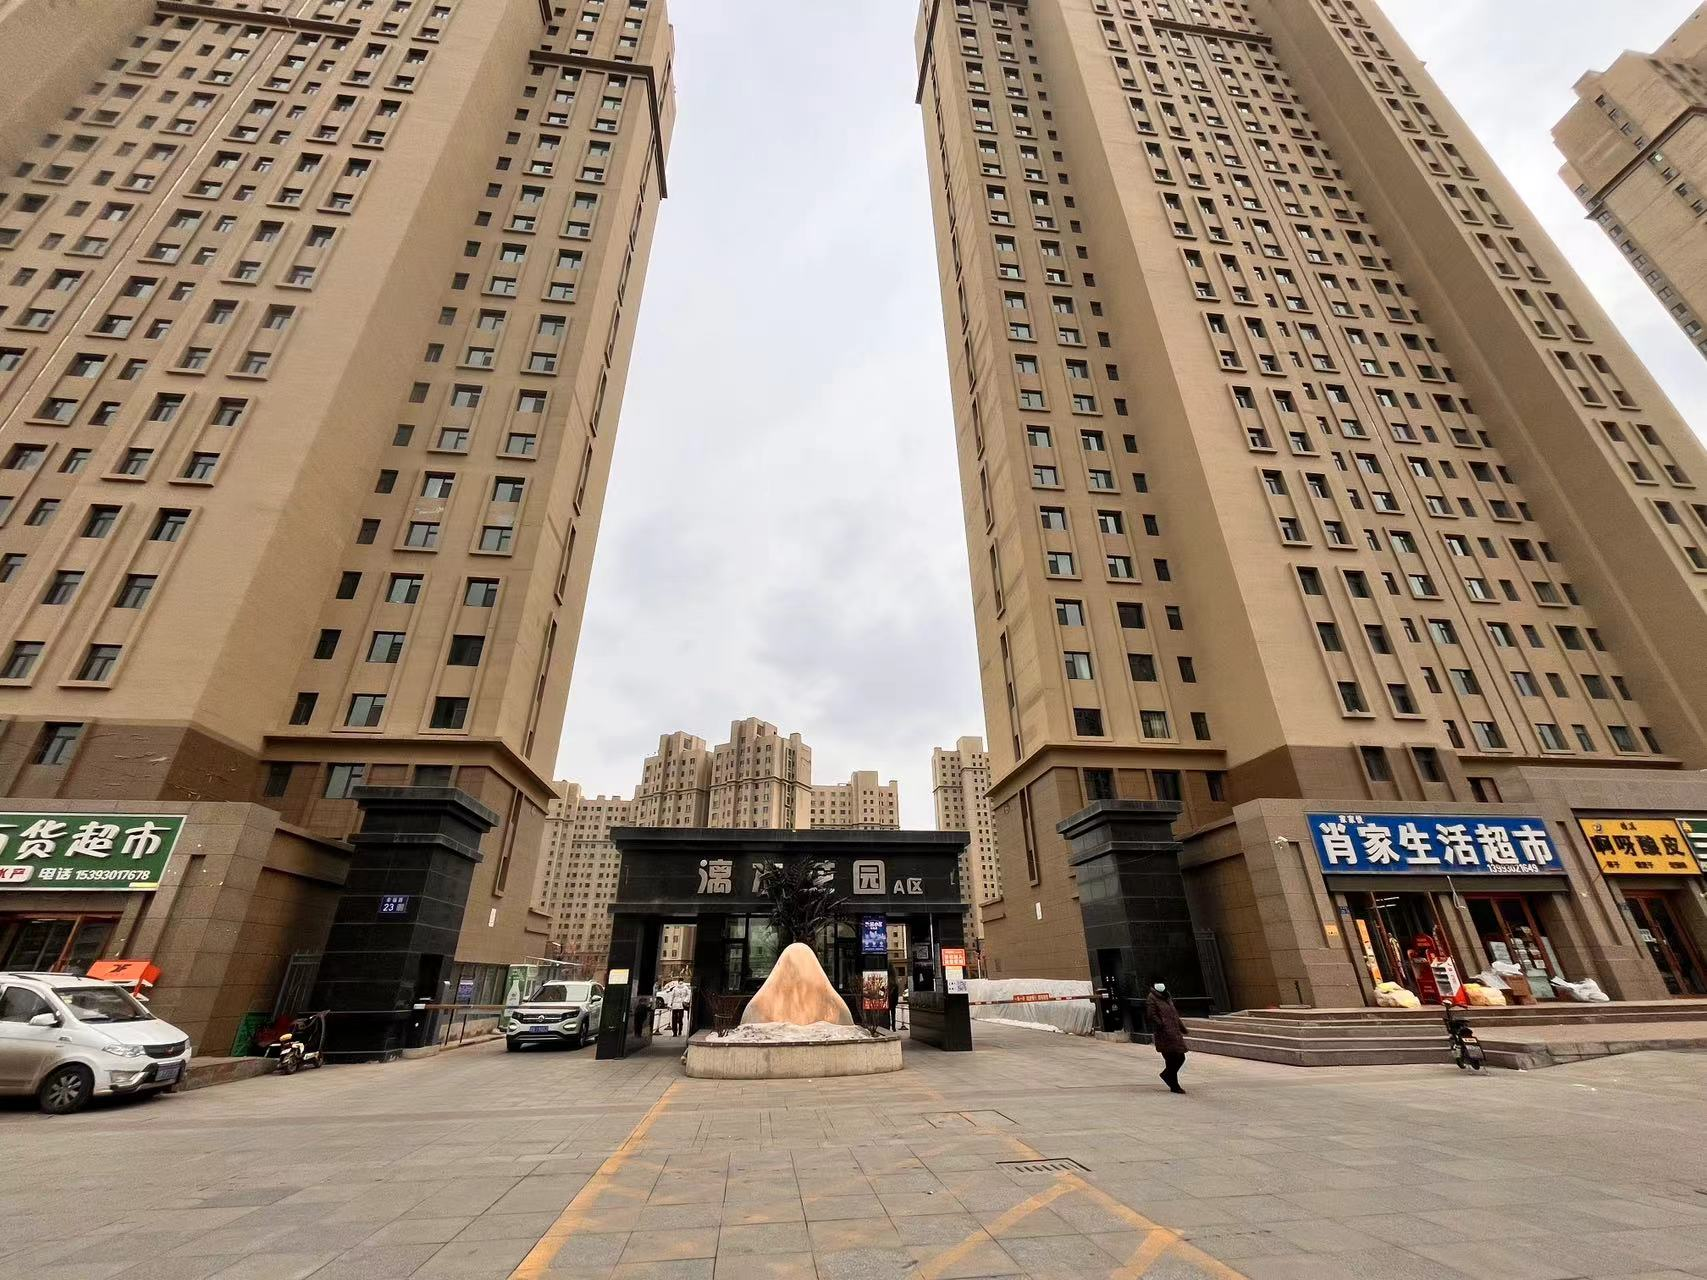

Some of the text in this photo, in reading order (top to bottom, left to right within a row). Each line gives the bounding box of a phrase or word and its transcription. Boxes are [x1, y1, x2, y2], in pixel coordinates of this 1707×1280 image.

[1319, 822, 1553, 865] 肖家生活超市
[38, 867, 151, 881] 电话 15393017678
